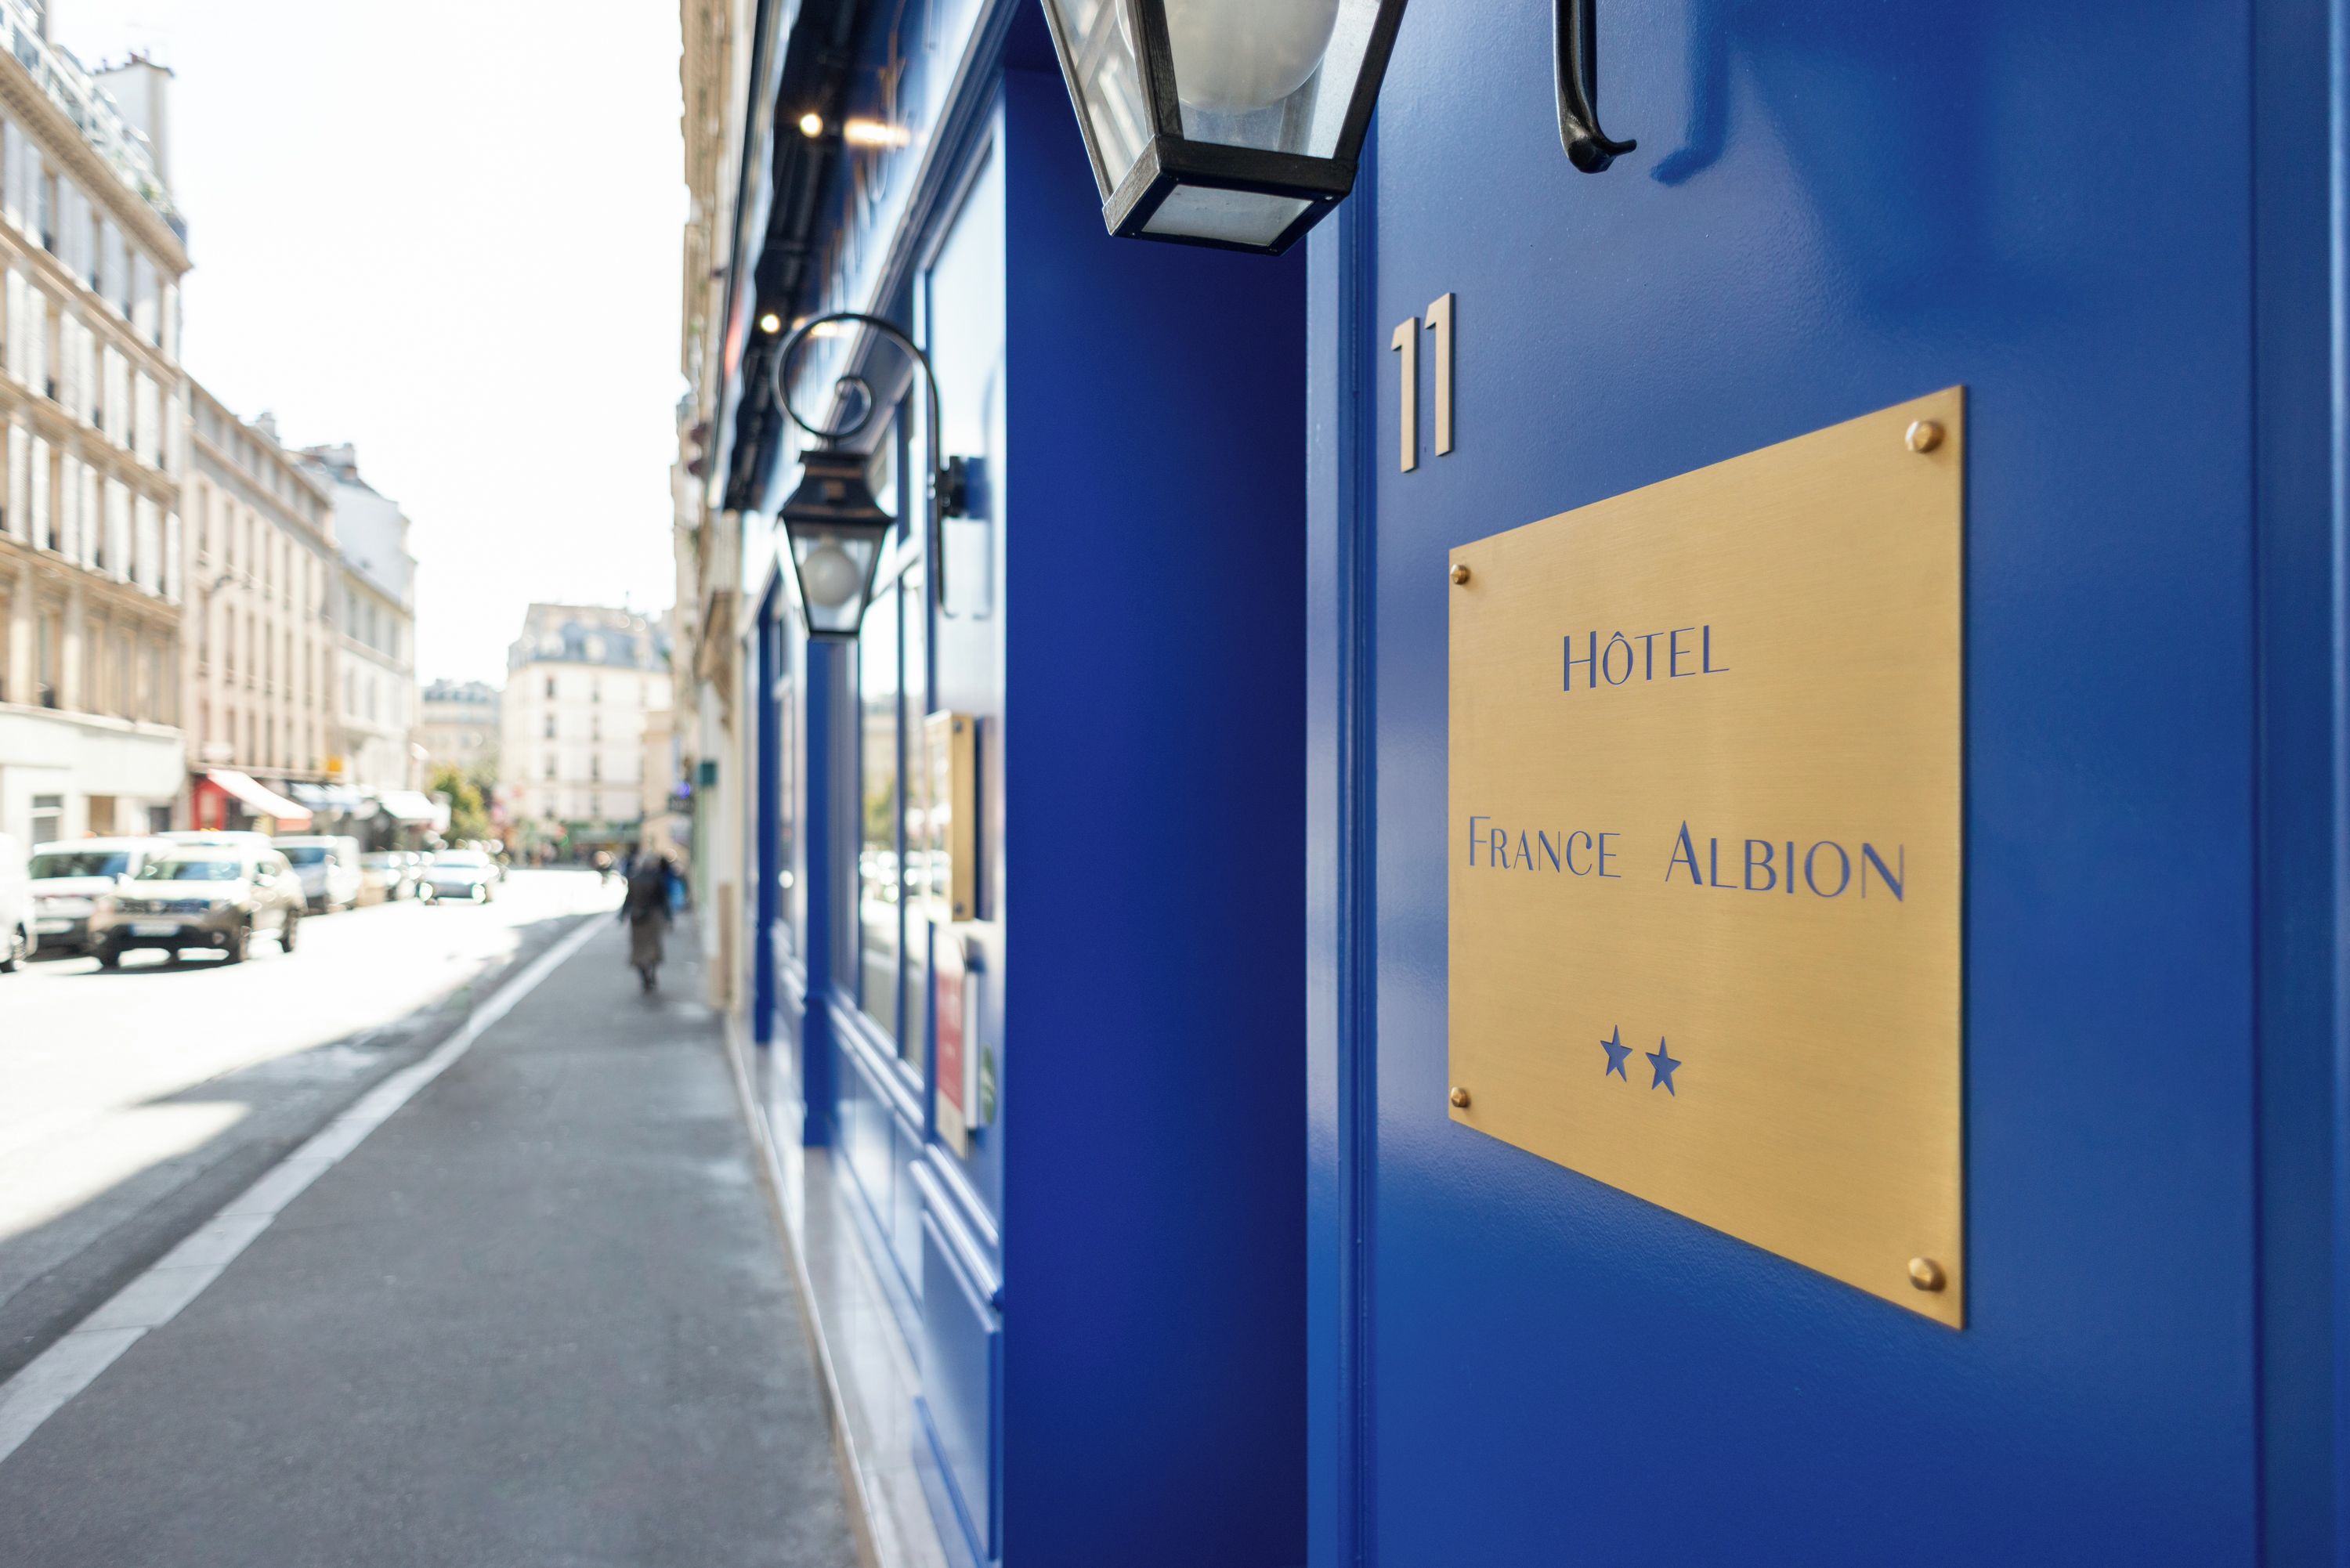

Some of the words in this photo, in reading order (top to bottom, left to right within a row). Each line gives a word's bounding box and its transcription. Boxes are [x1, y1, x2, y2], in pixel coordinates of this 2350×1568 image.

[1390, 292, 1455, 472] 11
[1564, 624, 1730, 692] HÔTEL
[1470, 816, 1622, 878] FRANCE
[1665, 820, 1905, 902] ALBION
